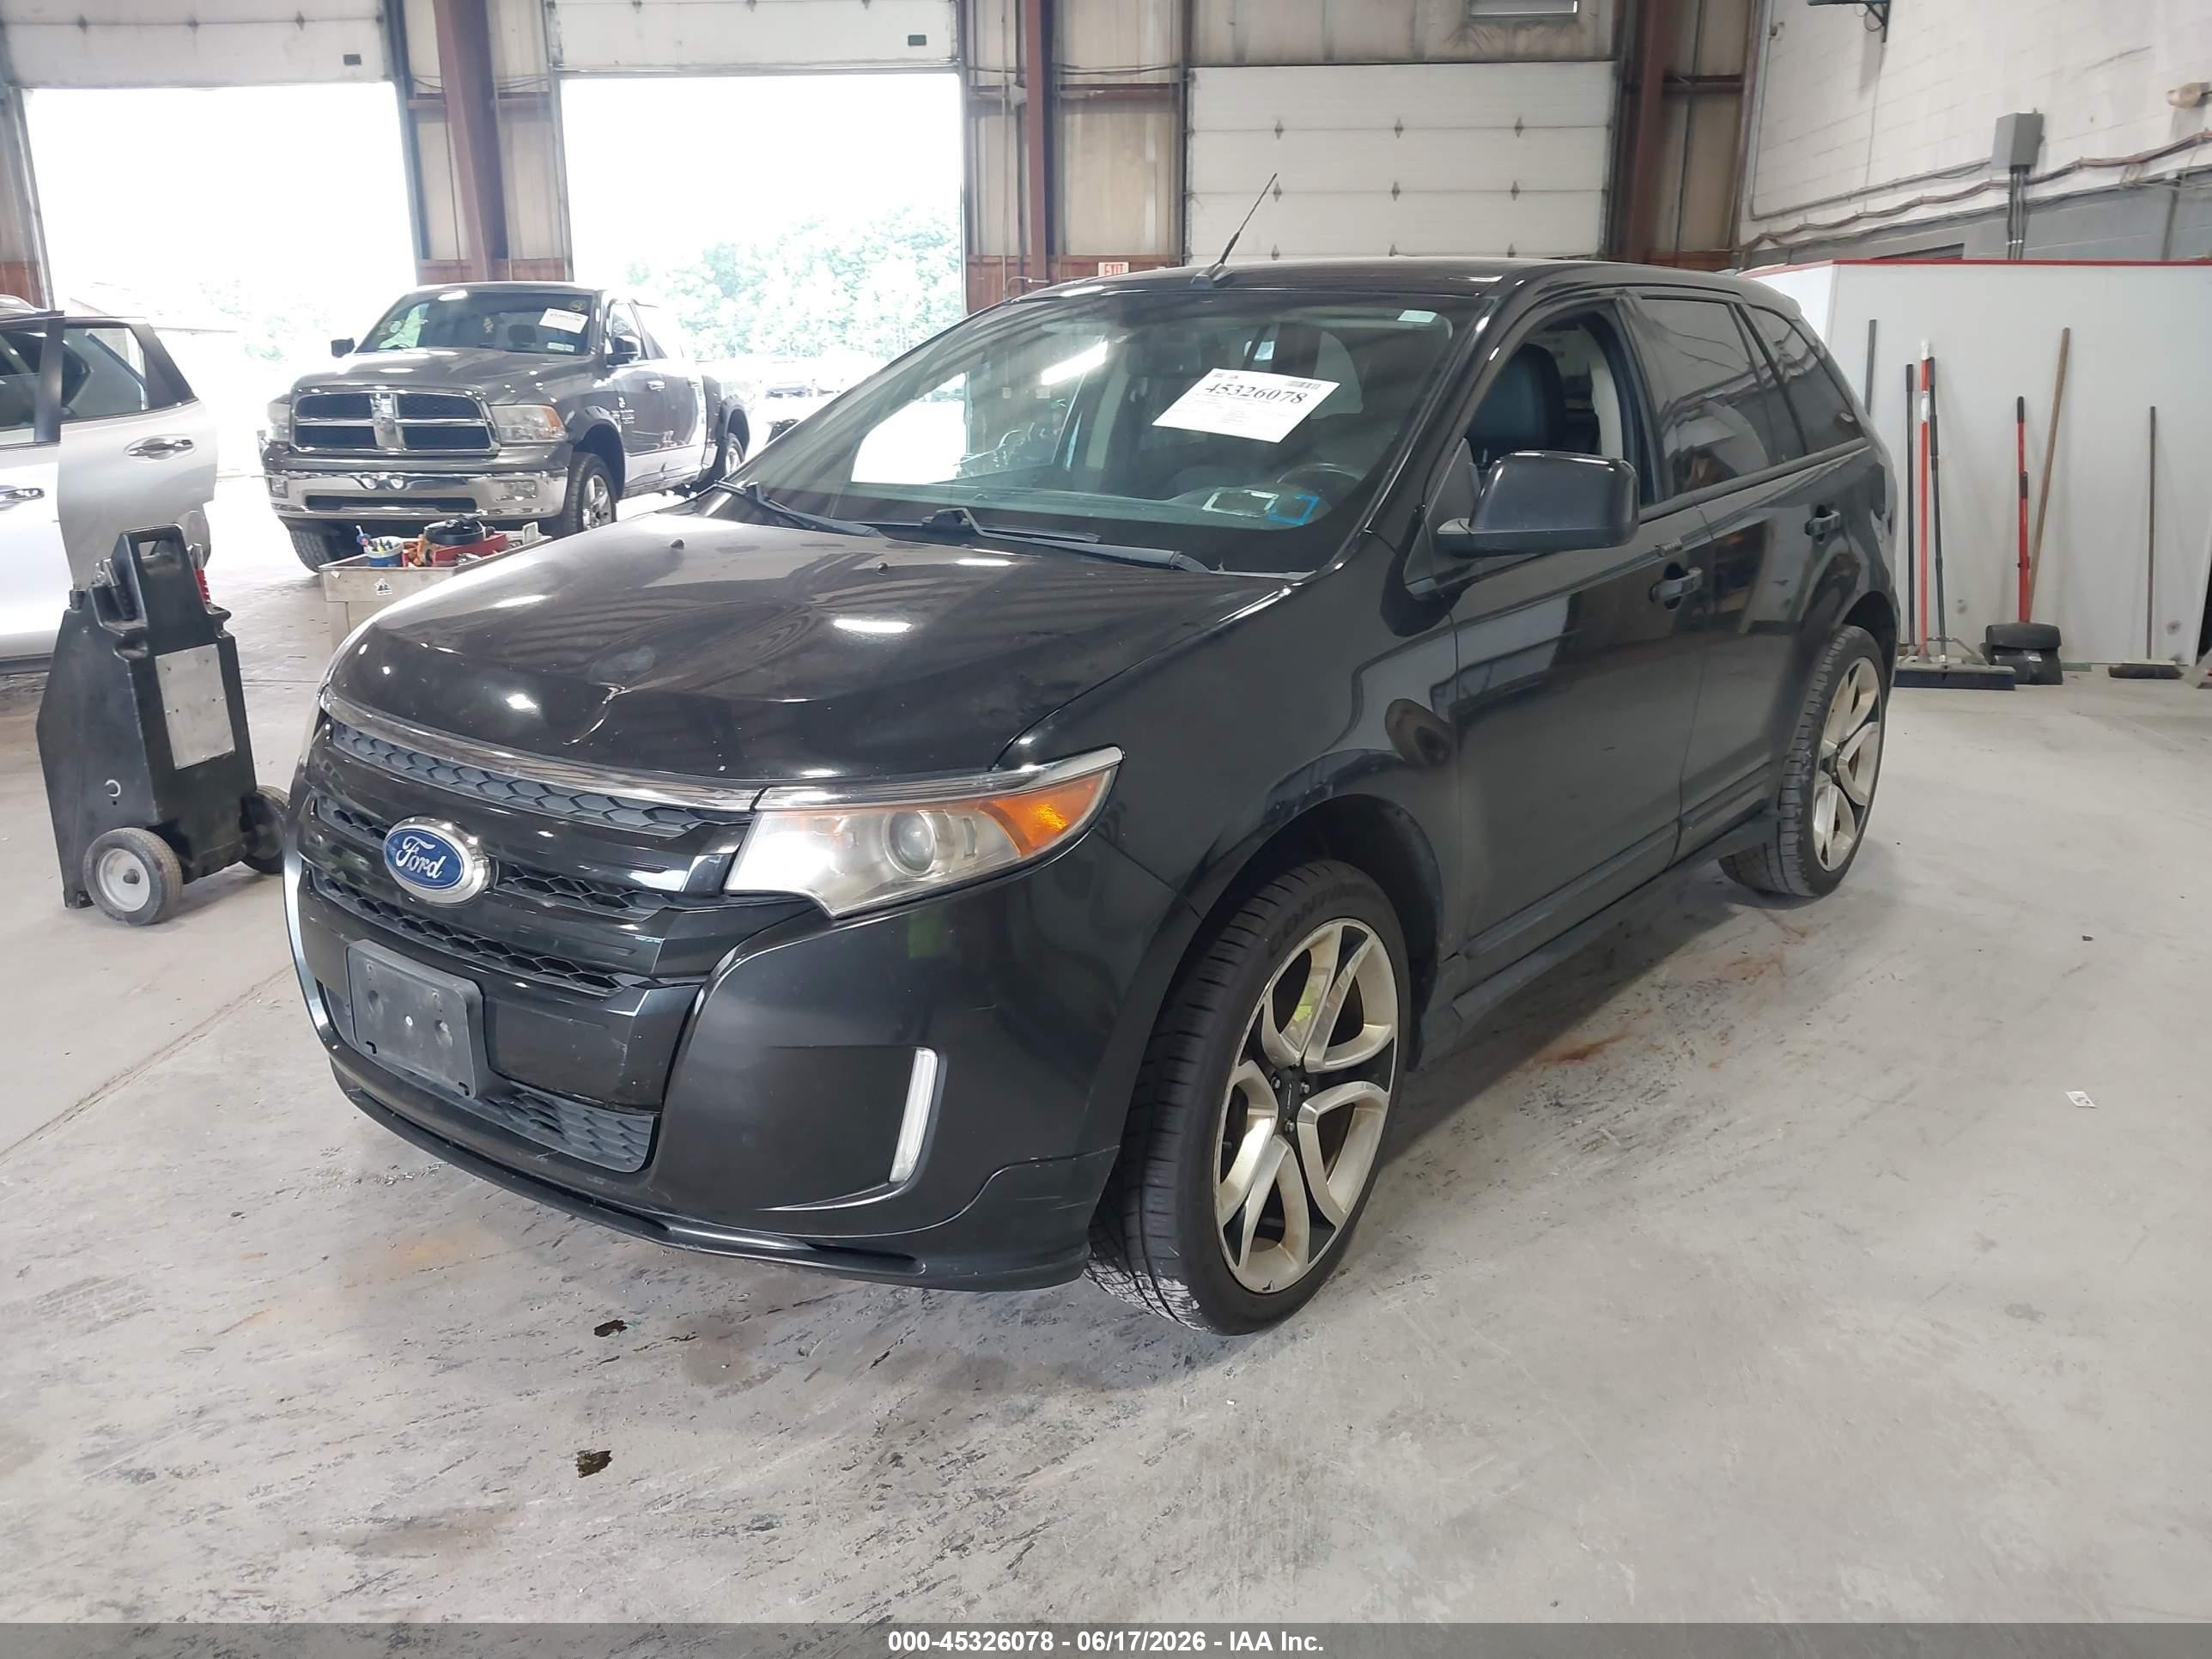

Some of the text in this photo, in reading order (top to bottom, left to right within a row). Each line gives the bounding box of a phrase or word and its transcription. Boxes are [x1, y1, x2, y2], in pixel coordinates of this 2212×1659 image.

[1104, 264, 1124, 275] EXIT
[1205, 383, 1308, 404] 45326078
[396, 836, 447, 878] Ford
